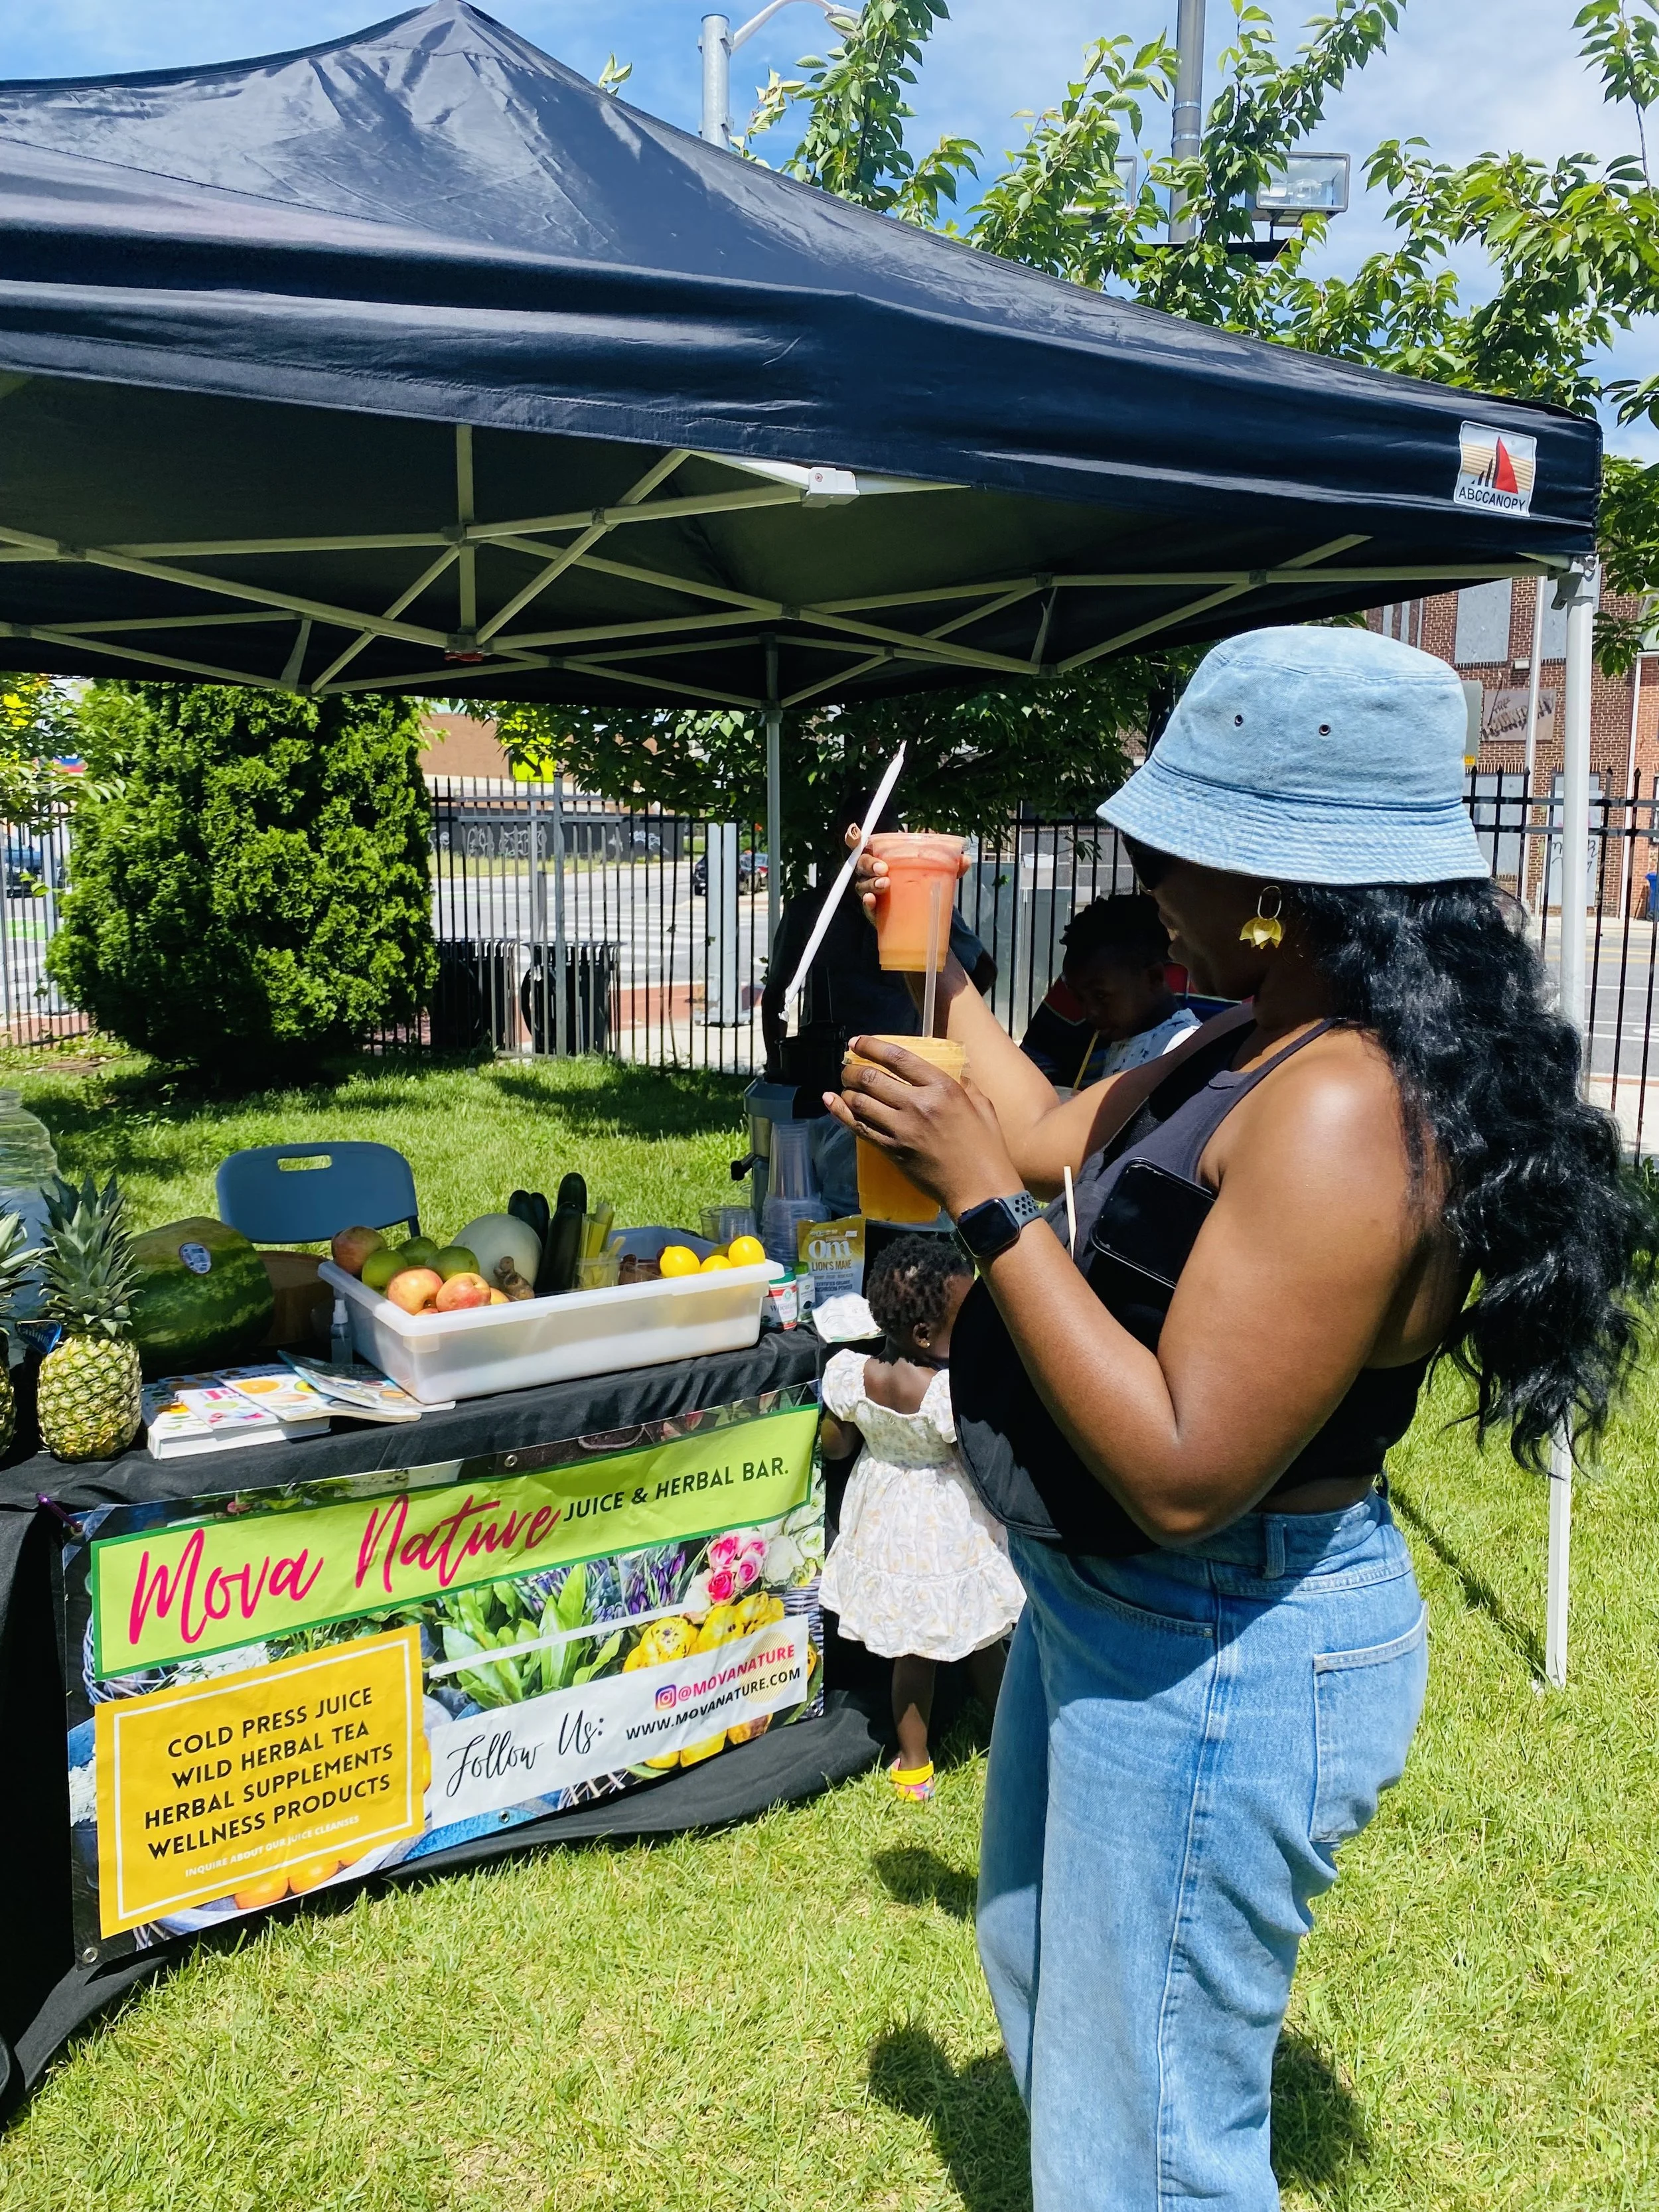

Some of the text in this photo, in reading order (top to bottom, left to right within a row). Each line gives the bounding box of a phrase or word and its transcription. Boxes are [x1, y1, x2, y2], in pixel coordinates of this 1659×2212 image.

[1459, 486, 1526, 511] ABCCANOPY
[812, 1261, 834, 1272] LION'S
[563, 1457, 788, 1522] JUICE & HERBAL BAR.
[128, 1494, 561, 1645] Mova Nature
[626, 1668, 801, 1741] WWW.MOVANATURE.COM
[678, 1644, 795, 1702] @MOVANATURE
[167, 1687, 372, 1757] COLD PRESS JUICE
[171, 1720, 370, 1789] WILD HERBAL TEA
[446, 1709, 605, 1798] Follow Us:
[145, 1743, 394, 1830] HERBAL SUPPLEMENTS
[148, 1774, 390, 1860] WELLNESS PRODUCTS
[185, 1815, 360, 1878] INQUIRE ABOUT OUR JUICE CLEANSES
